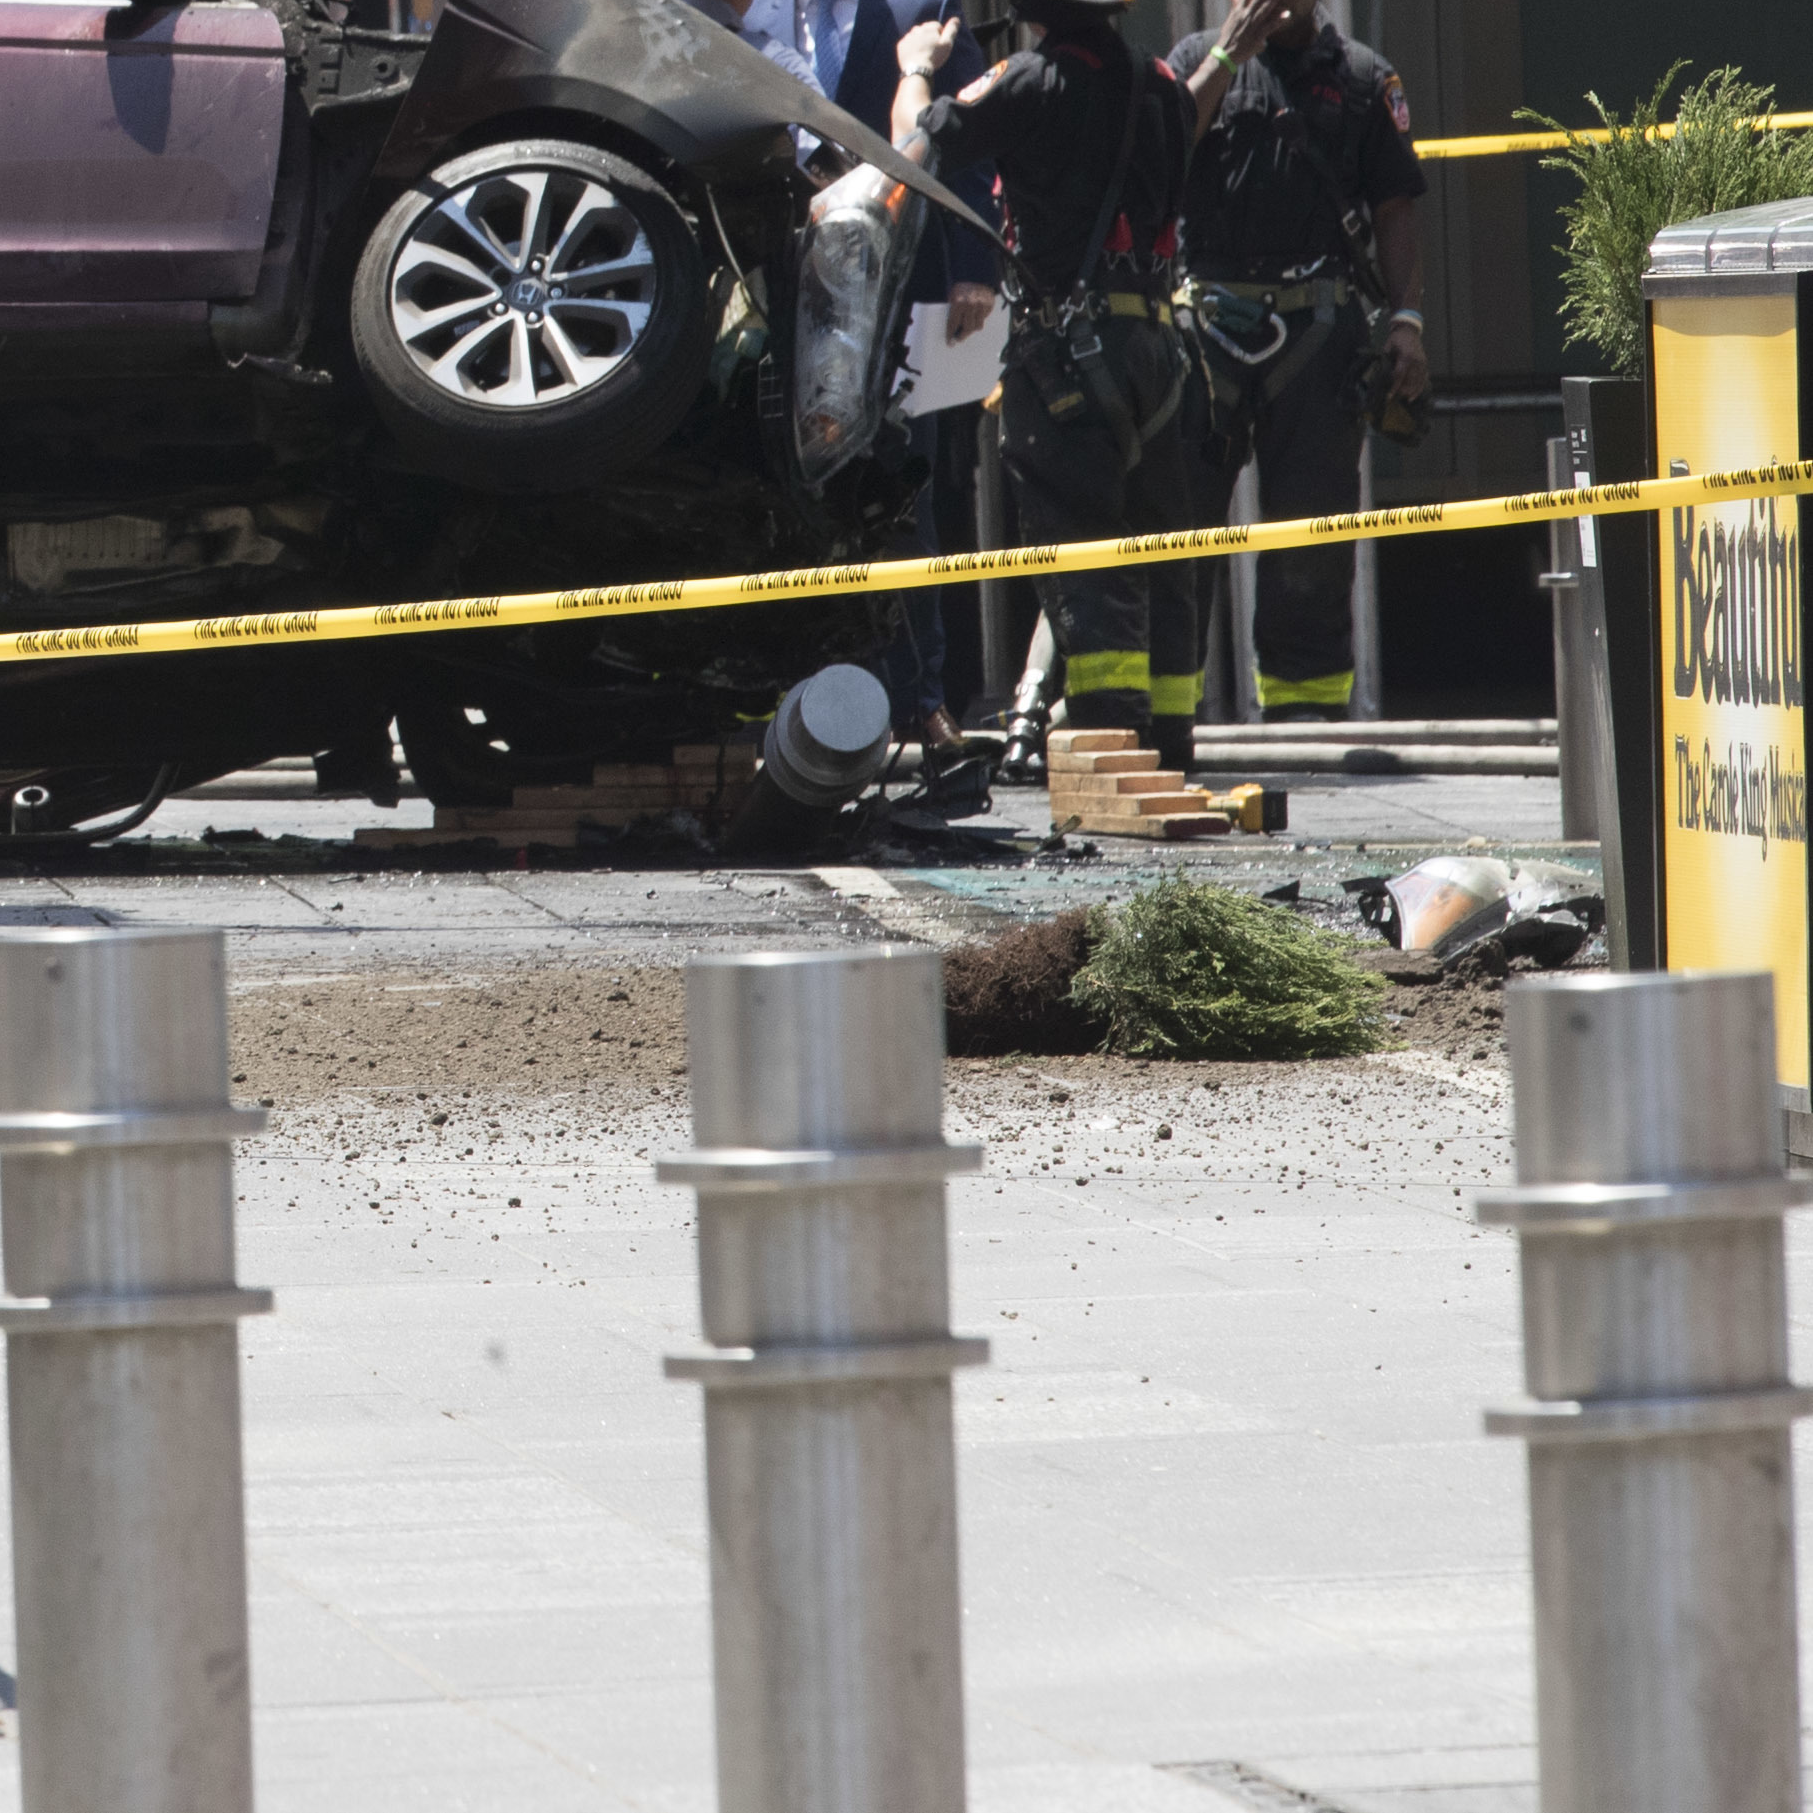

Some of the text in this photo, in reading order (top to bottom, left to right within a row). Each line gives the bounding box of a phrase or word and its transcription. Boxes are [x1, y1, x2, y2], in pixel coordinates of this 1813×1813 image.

[1675, 734, 1701, 831] The
[1703, 737, 1739, 836] Carole
[1740, 741, 1768, 863] King
